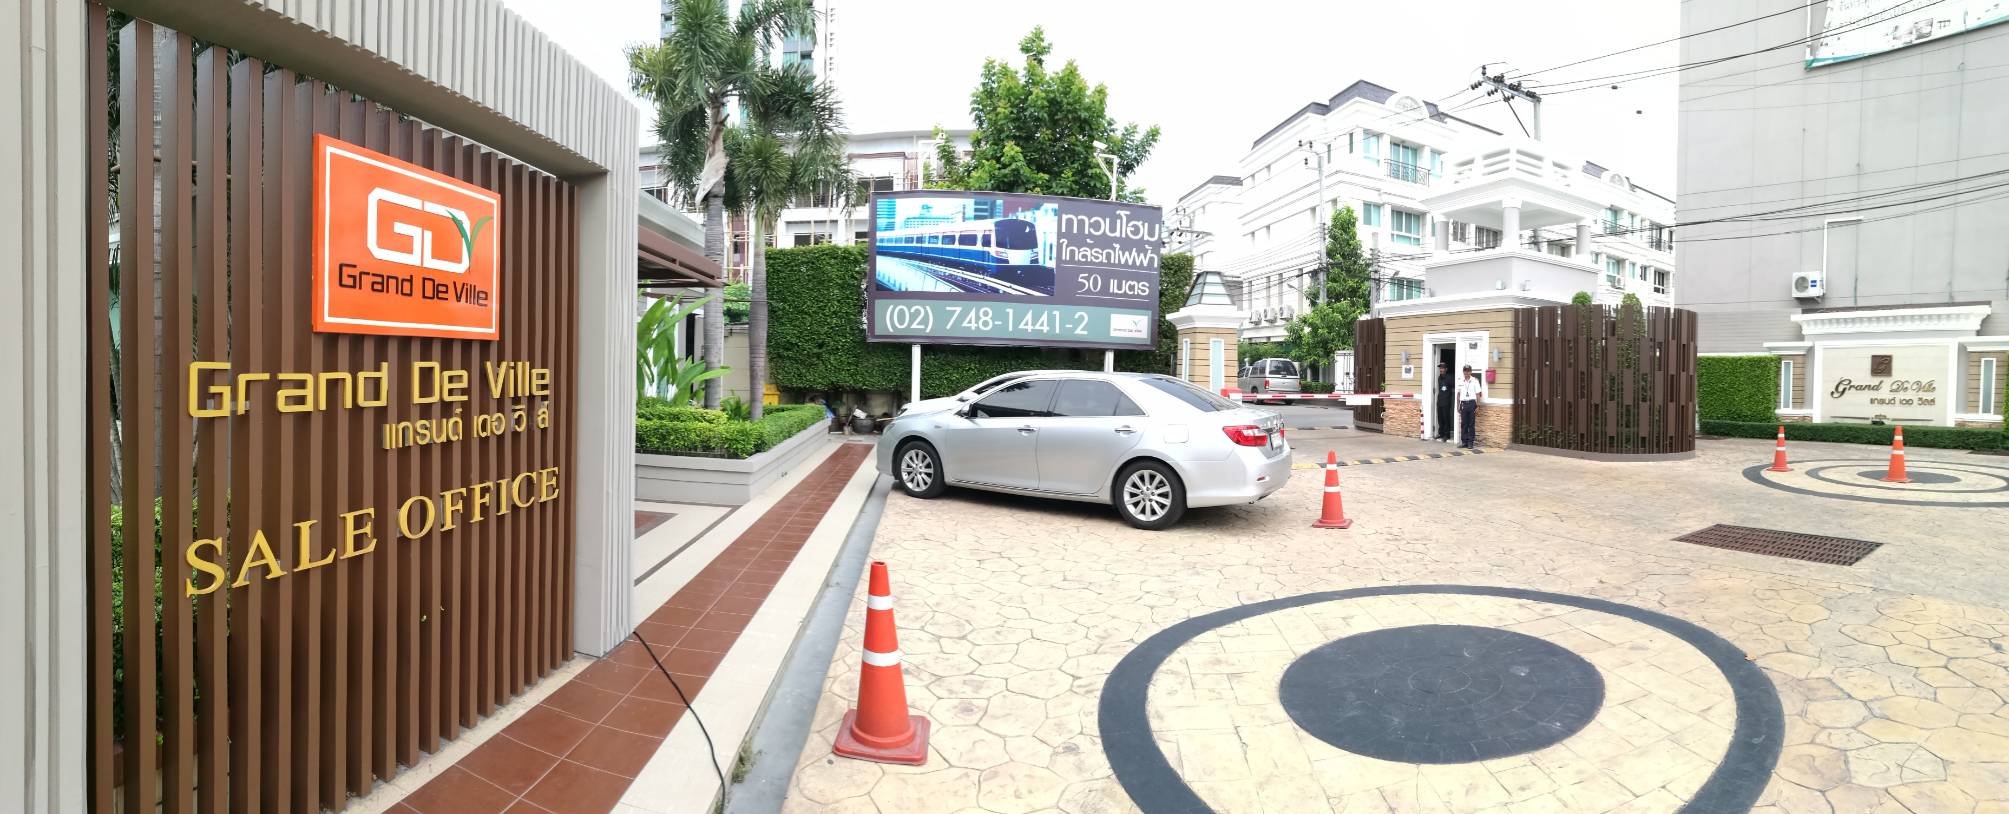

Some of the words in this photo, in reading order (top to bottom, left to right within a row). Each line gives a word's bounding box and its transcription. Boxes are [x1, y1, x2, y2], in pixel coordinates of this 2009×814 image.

[1060, 238, 1158, 268] ใกล้รถไฟฟ้า
[338, 262, 414, 297] Grand
[421, 277, 449, 301] De
[453, 281, 489, 308] Ville
[1077, 273, 1102, 293] 50
[1109, 278, 1150, 296] เมตร
[885, 304, 934, 333] (02)
[945, 306, 1089, 335] 748-1441-2
[188, 361, 389, 417] Grand
[412, 361, 469, 404] De
[484, 360, 550, 399] Ville
[1830, 377, 1884, 399] Grand
[382, 407, 463, 449] แกรนด์
[185, 507, 377, 598] SALE
[398, 467, 560, 539] OFFICE
